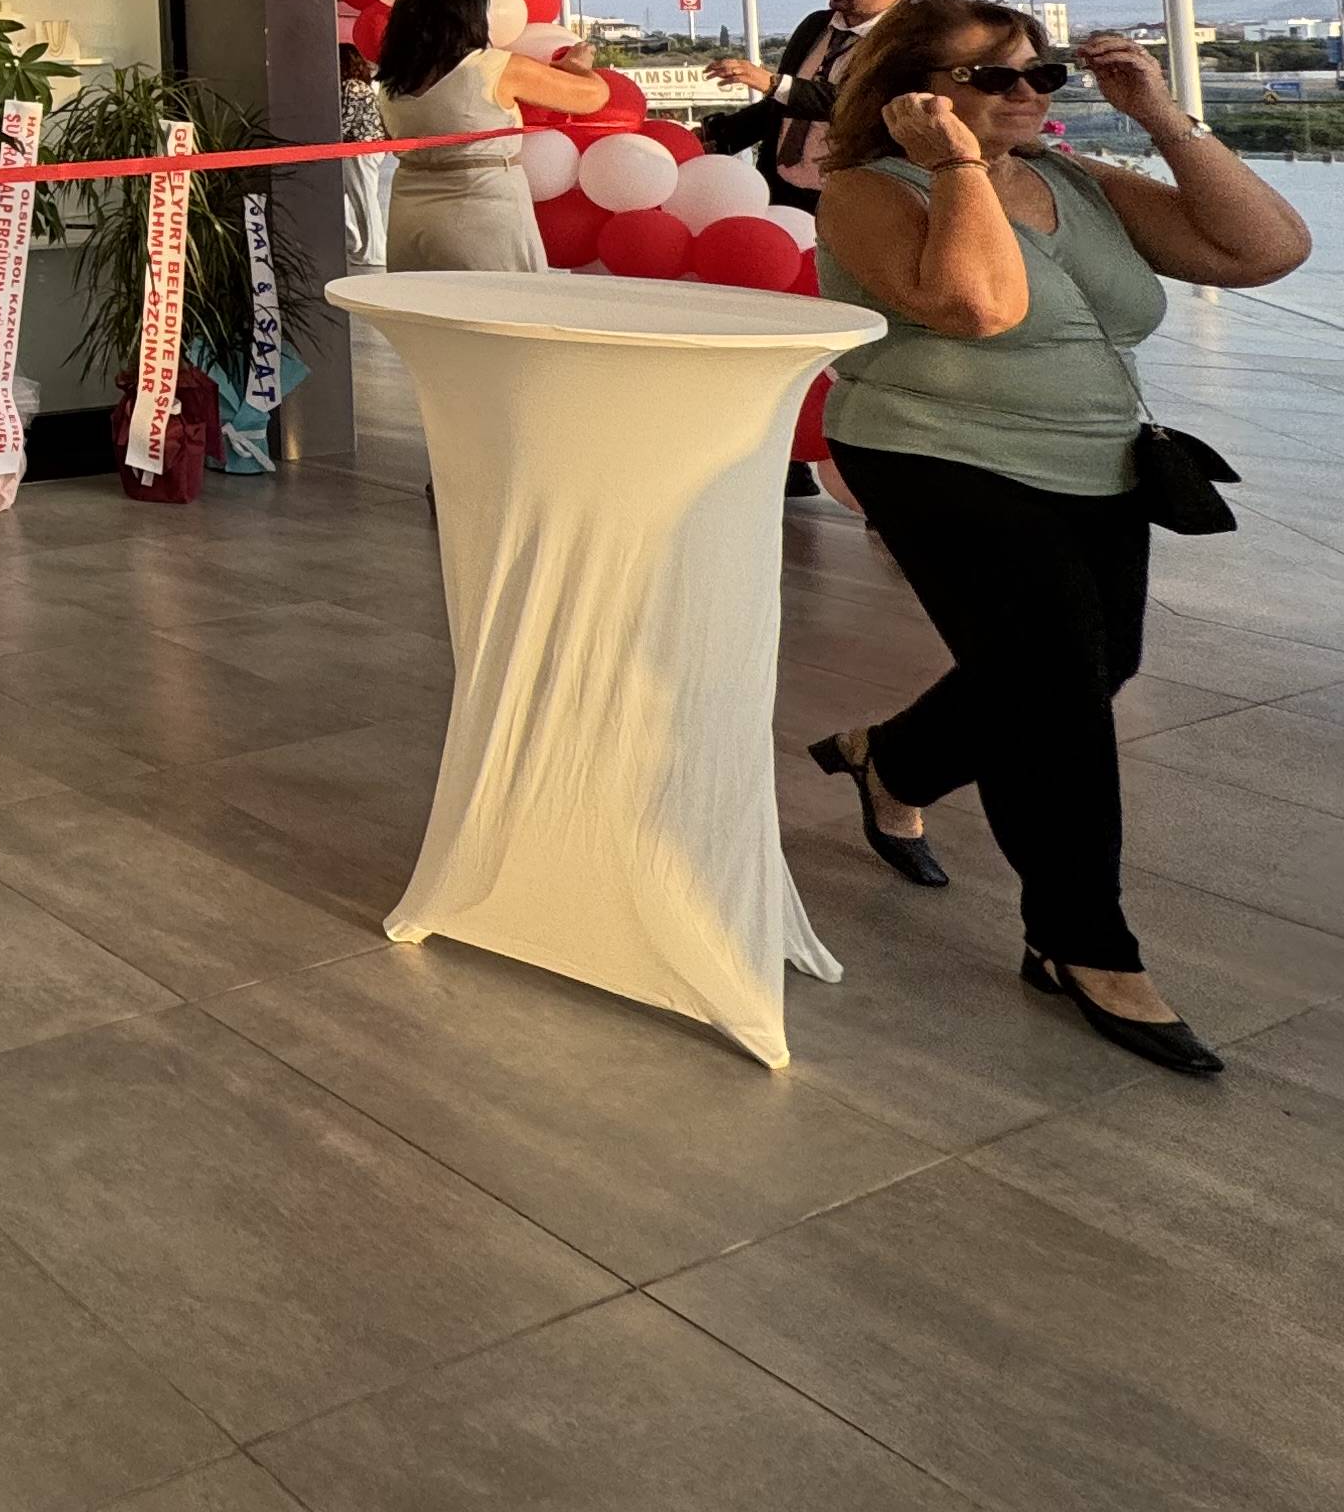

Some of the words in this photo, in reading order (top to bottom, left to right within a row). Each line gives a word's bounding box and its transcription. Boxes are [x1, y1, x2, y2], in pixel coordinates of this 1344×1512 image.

[14, 189, 30, 249] OLSUN,
[168, 128, 188, 254] GÜELYURT
[11, 256, 23, 288] BOL
[162, 262, 181, 360] BELEDİYE
[252, 319, 278, 402] SAAT
[148, 368, 174, 460] BAŞKANI
